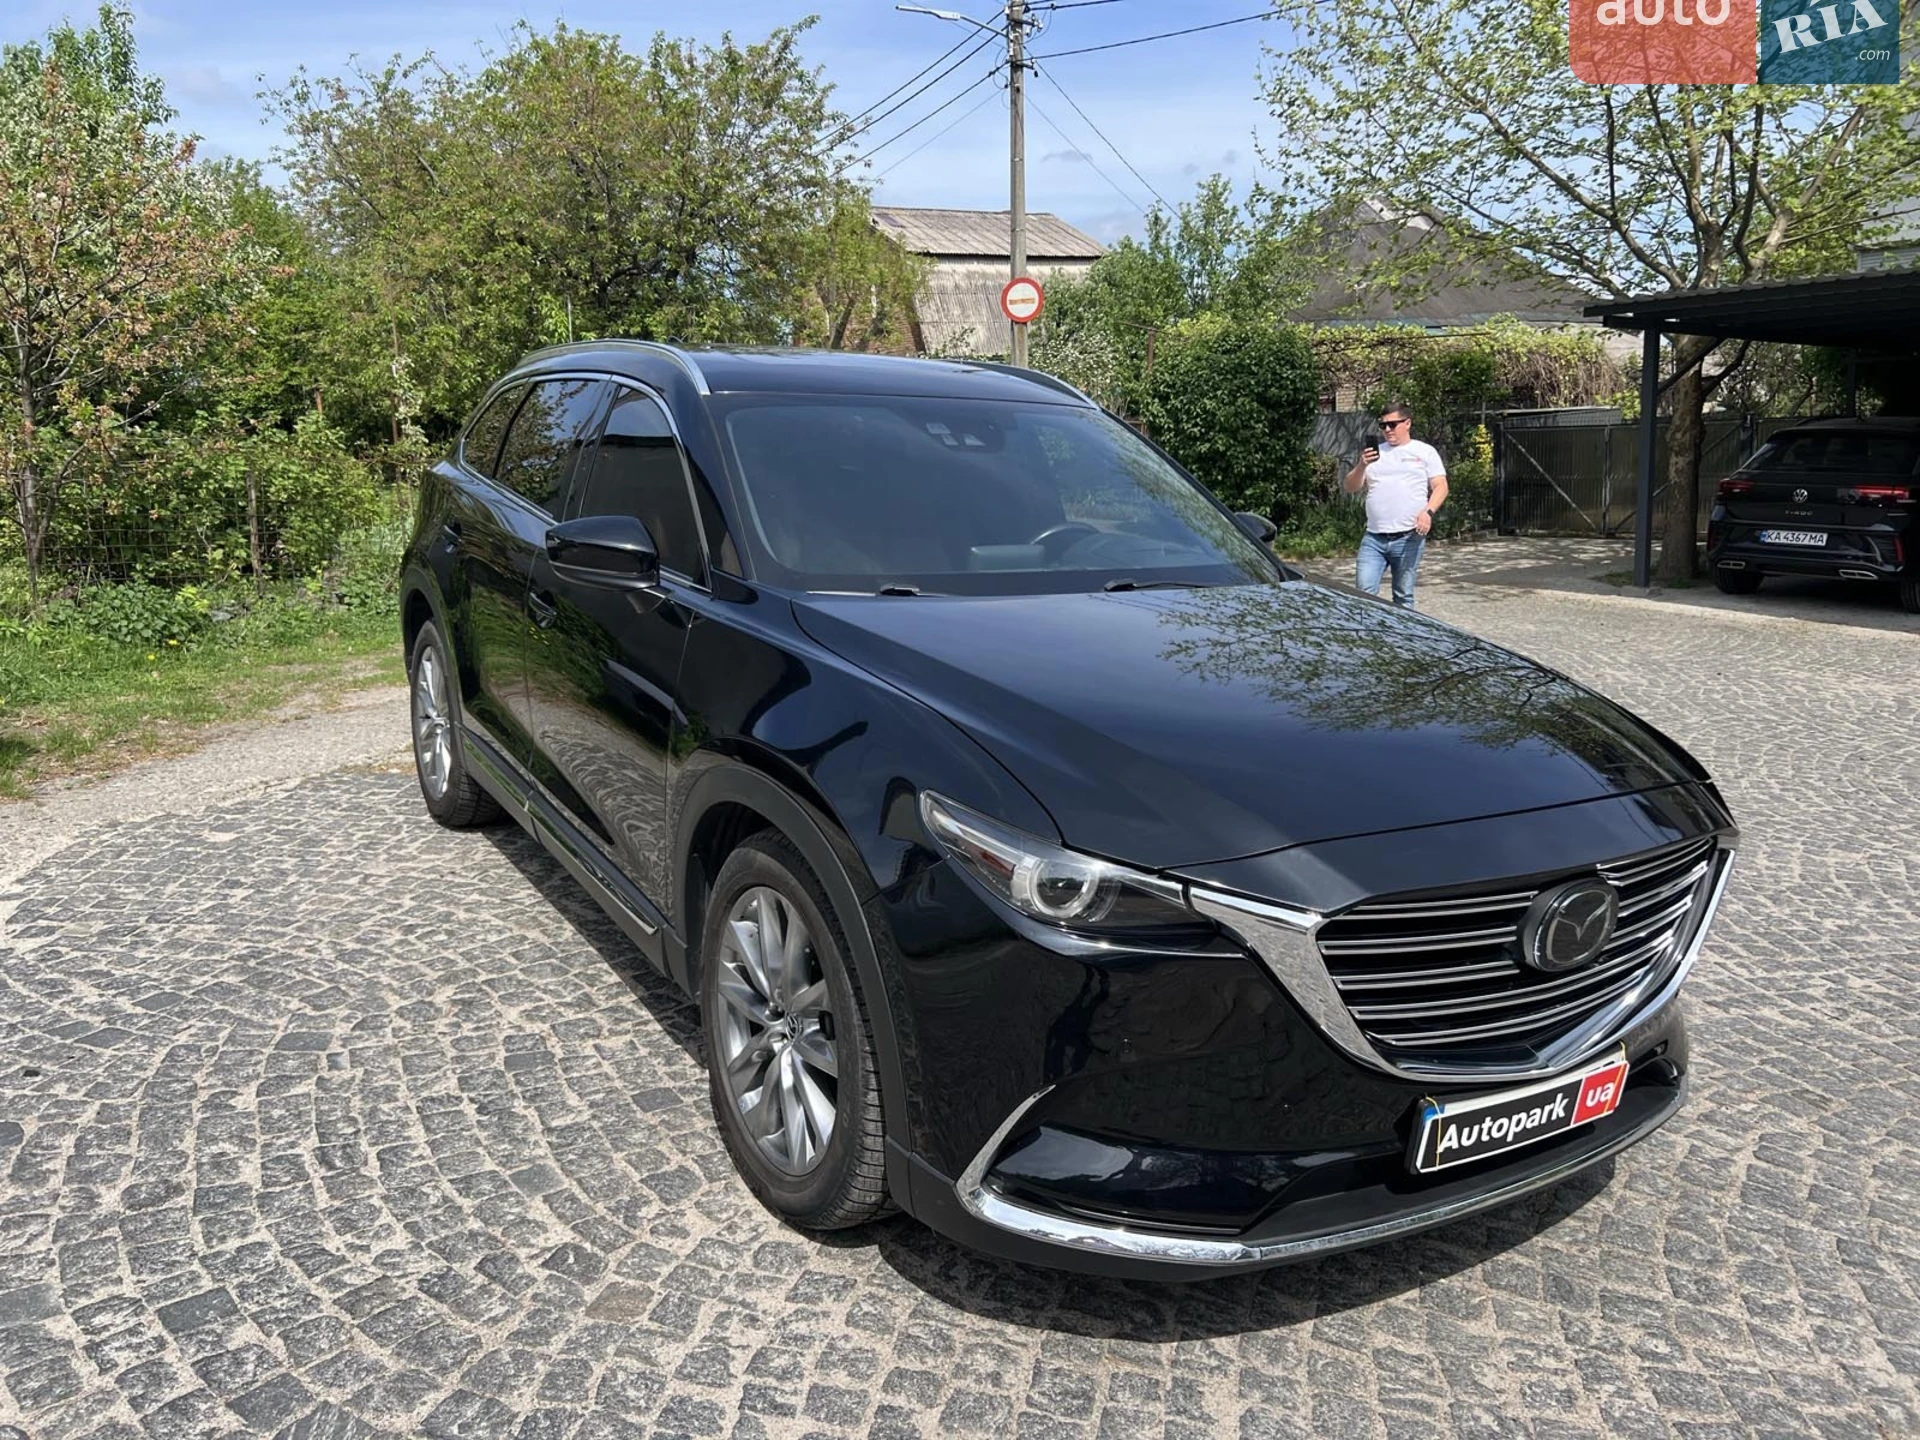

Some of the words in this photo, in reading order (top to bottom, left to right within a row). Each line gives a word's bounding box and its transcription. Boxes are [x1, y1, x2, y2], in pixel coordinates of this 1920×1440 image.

[1767, 531, 1781, 541] KA
[1783, 532, 1808, 543] 4367
[1809, 533, 1825, 544] MA
[1437, 1092, 1570, 1153] Autopark
[1585, 1081, 1615, 1108] ua
